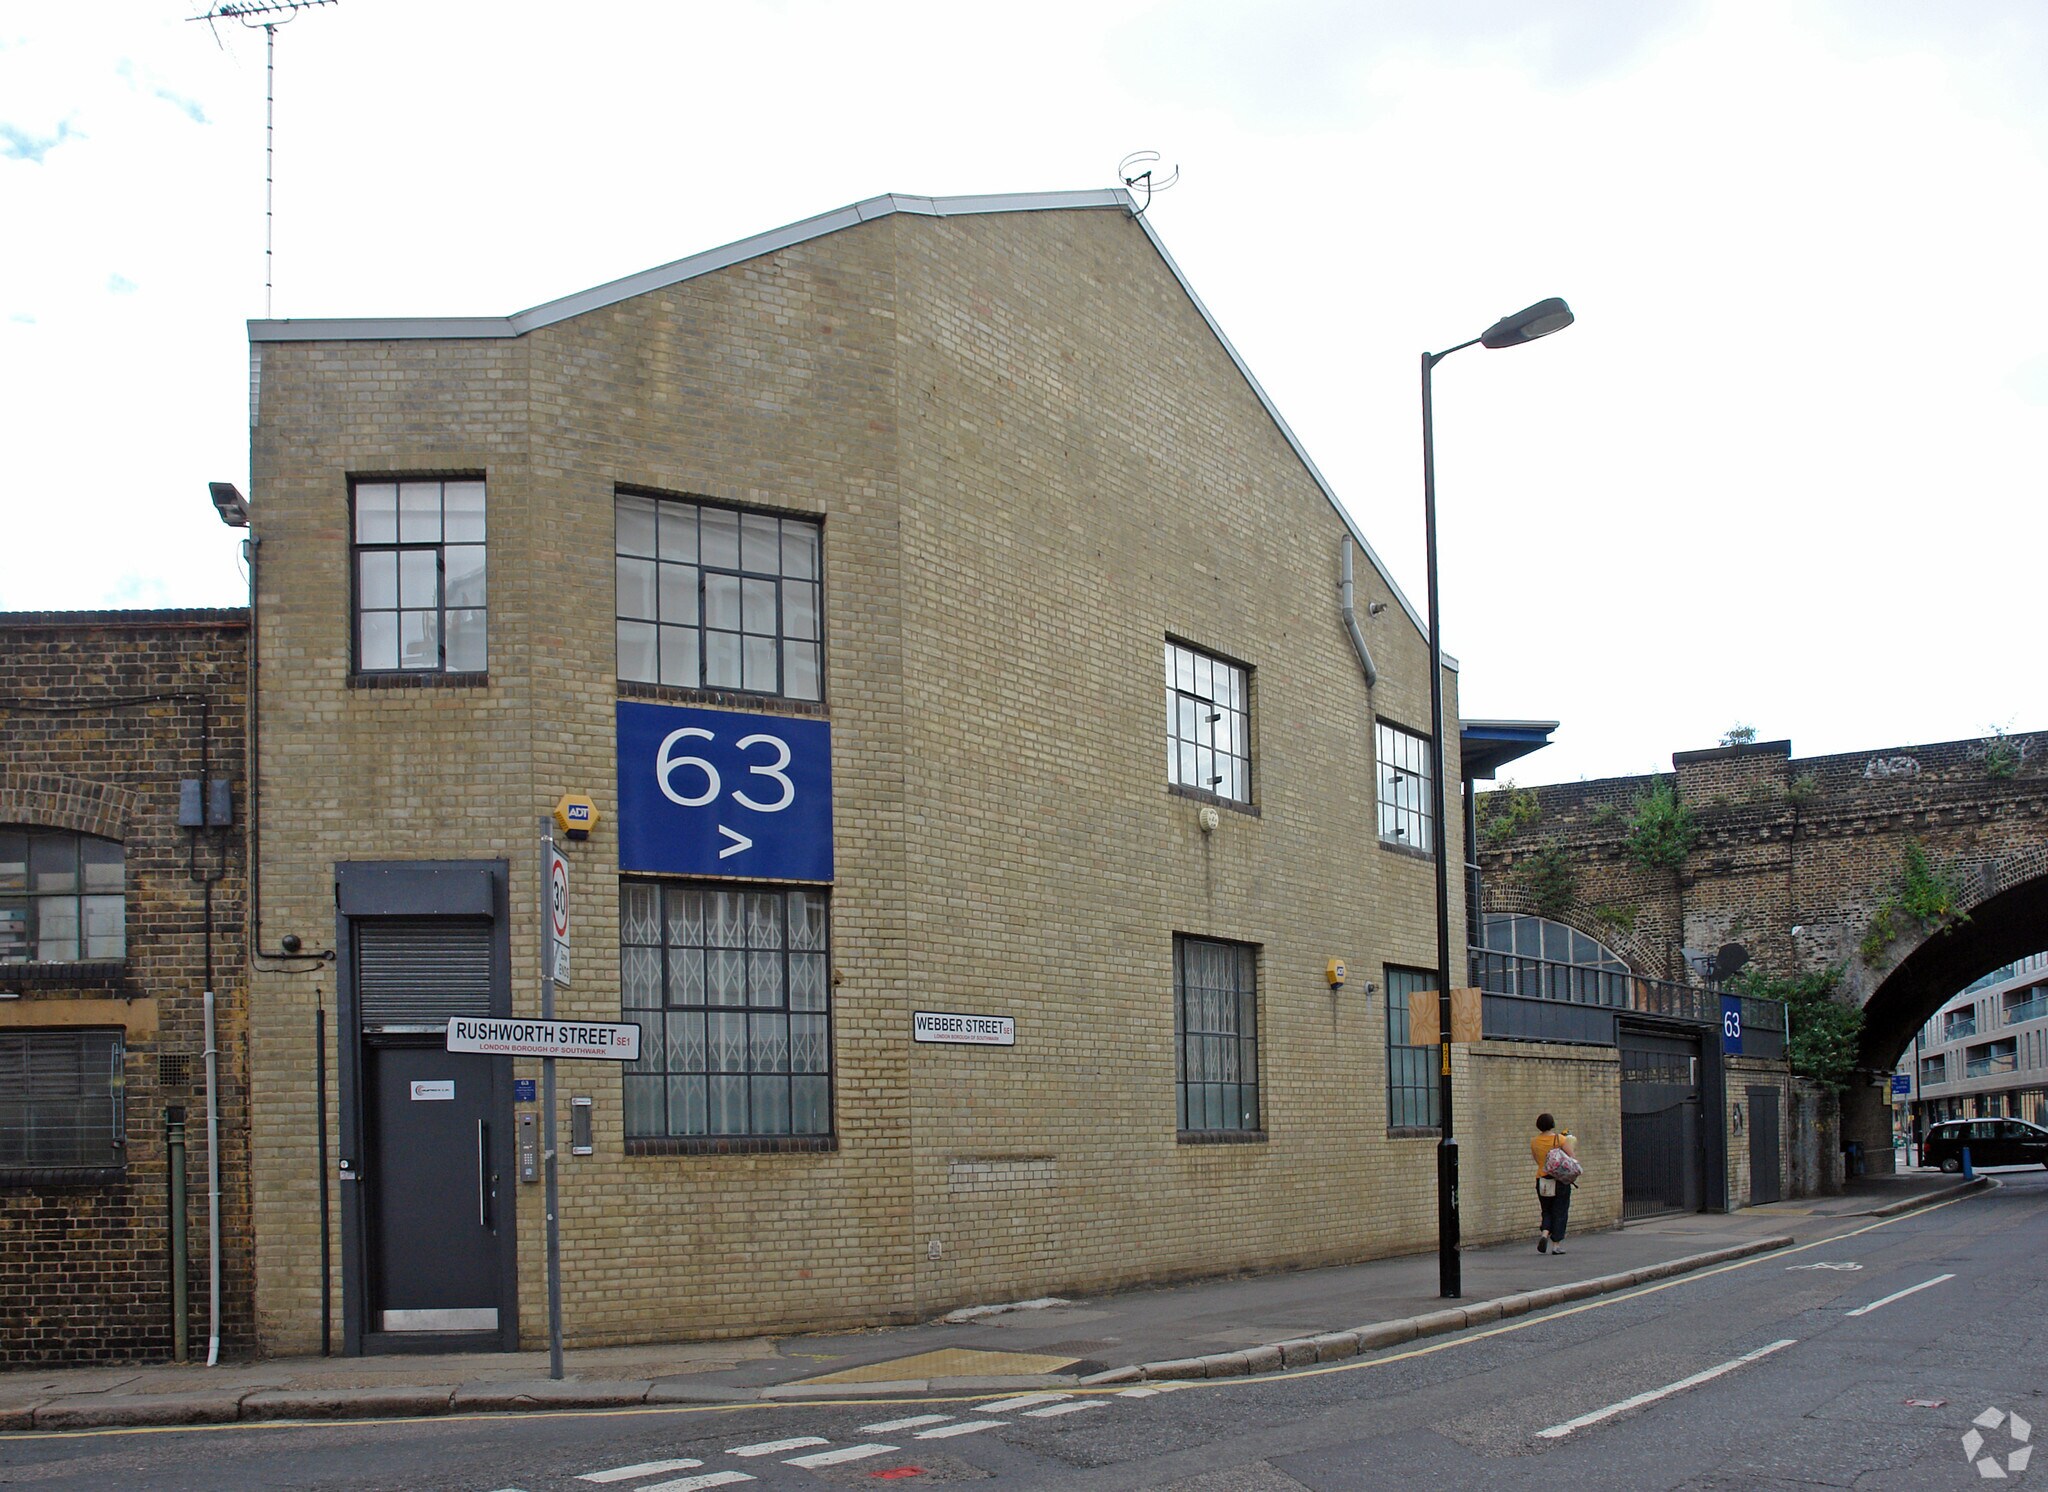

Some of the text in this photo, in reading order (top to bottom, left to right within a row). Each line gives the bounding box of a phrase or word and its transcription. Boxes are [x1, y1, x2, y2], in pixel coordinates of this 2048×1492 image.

[656, 727, 795, 813] 63
[569, 807, 589, 818] ADT
[554, 881, 566, 915] 30
[456, 1022, 630, 1046] RUSHWORTH STREET SE1
[916, 1016, 1013, 1035] WEBBER STREET SE1
[1724, 1011, 1740, 1038] 63
[479, 1043, 510, 1051] LONDON
[511, 1044, 548, 1053] BOROUGH
[561, 1046, 606, 1055] SOUTHWARK
